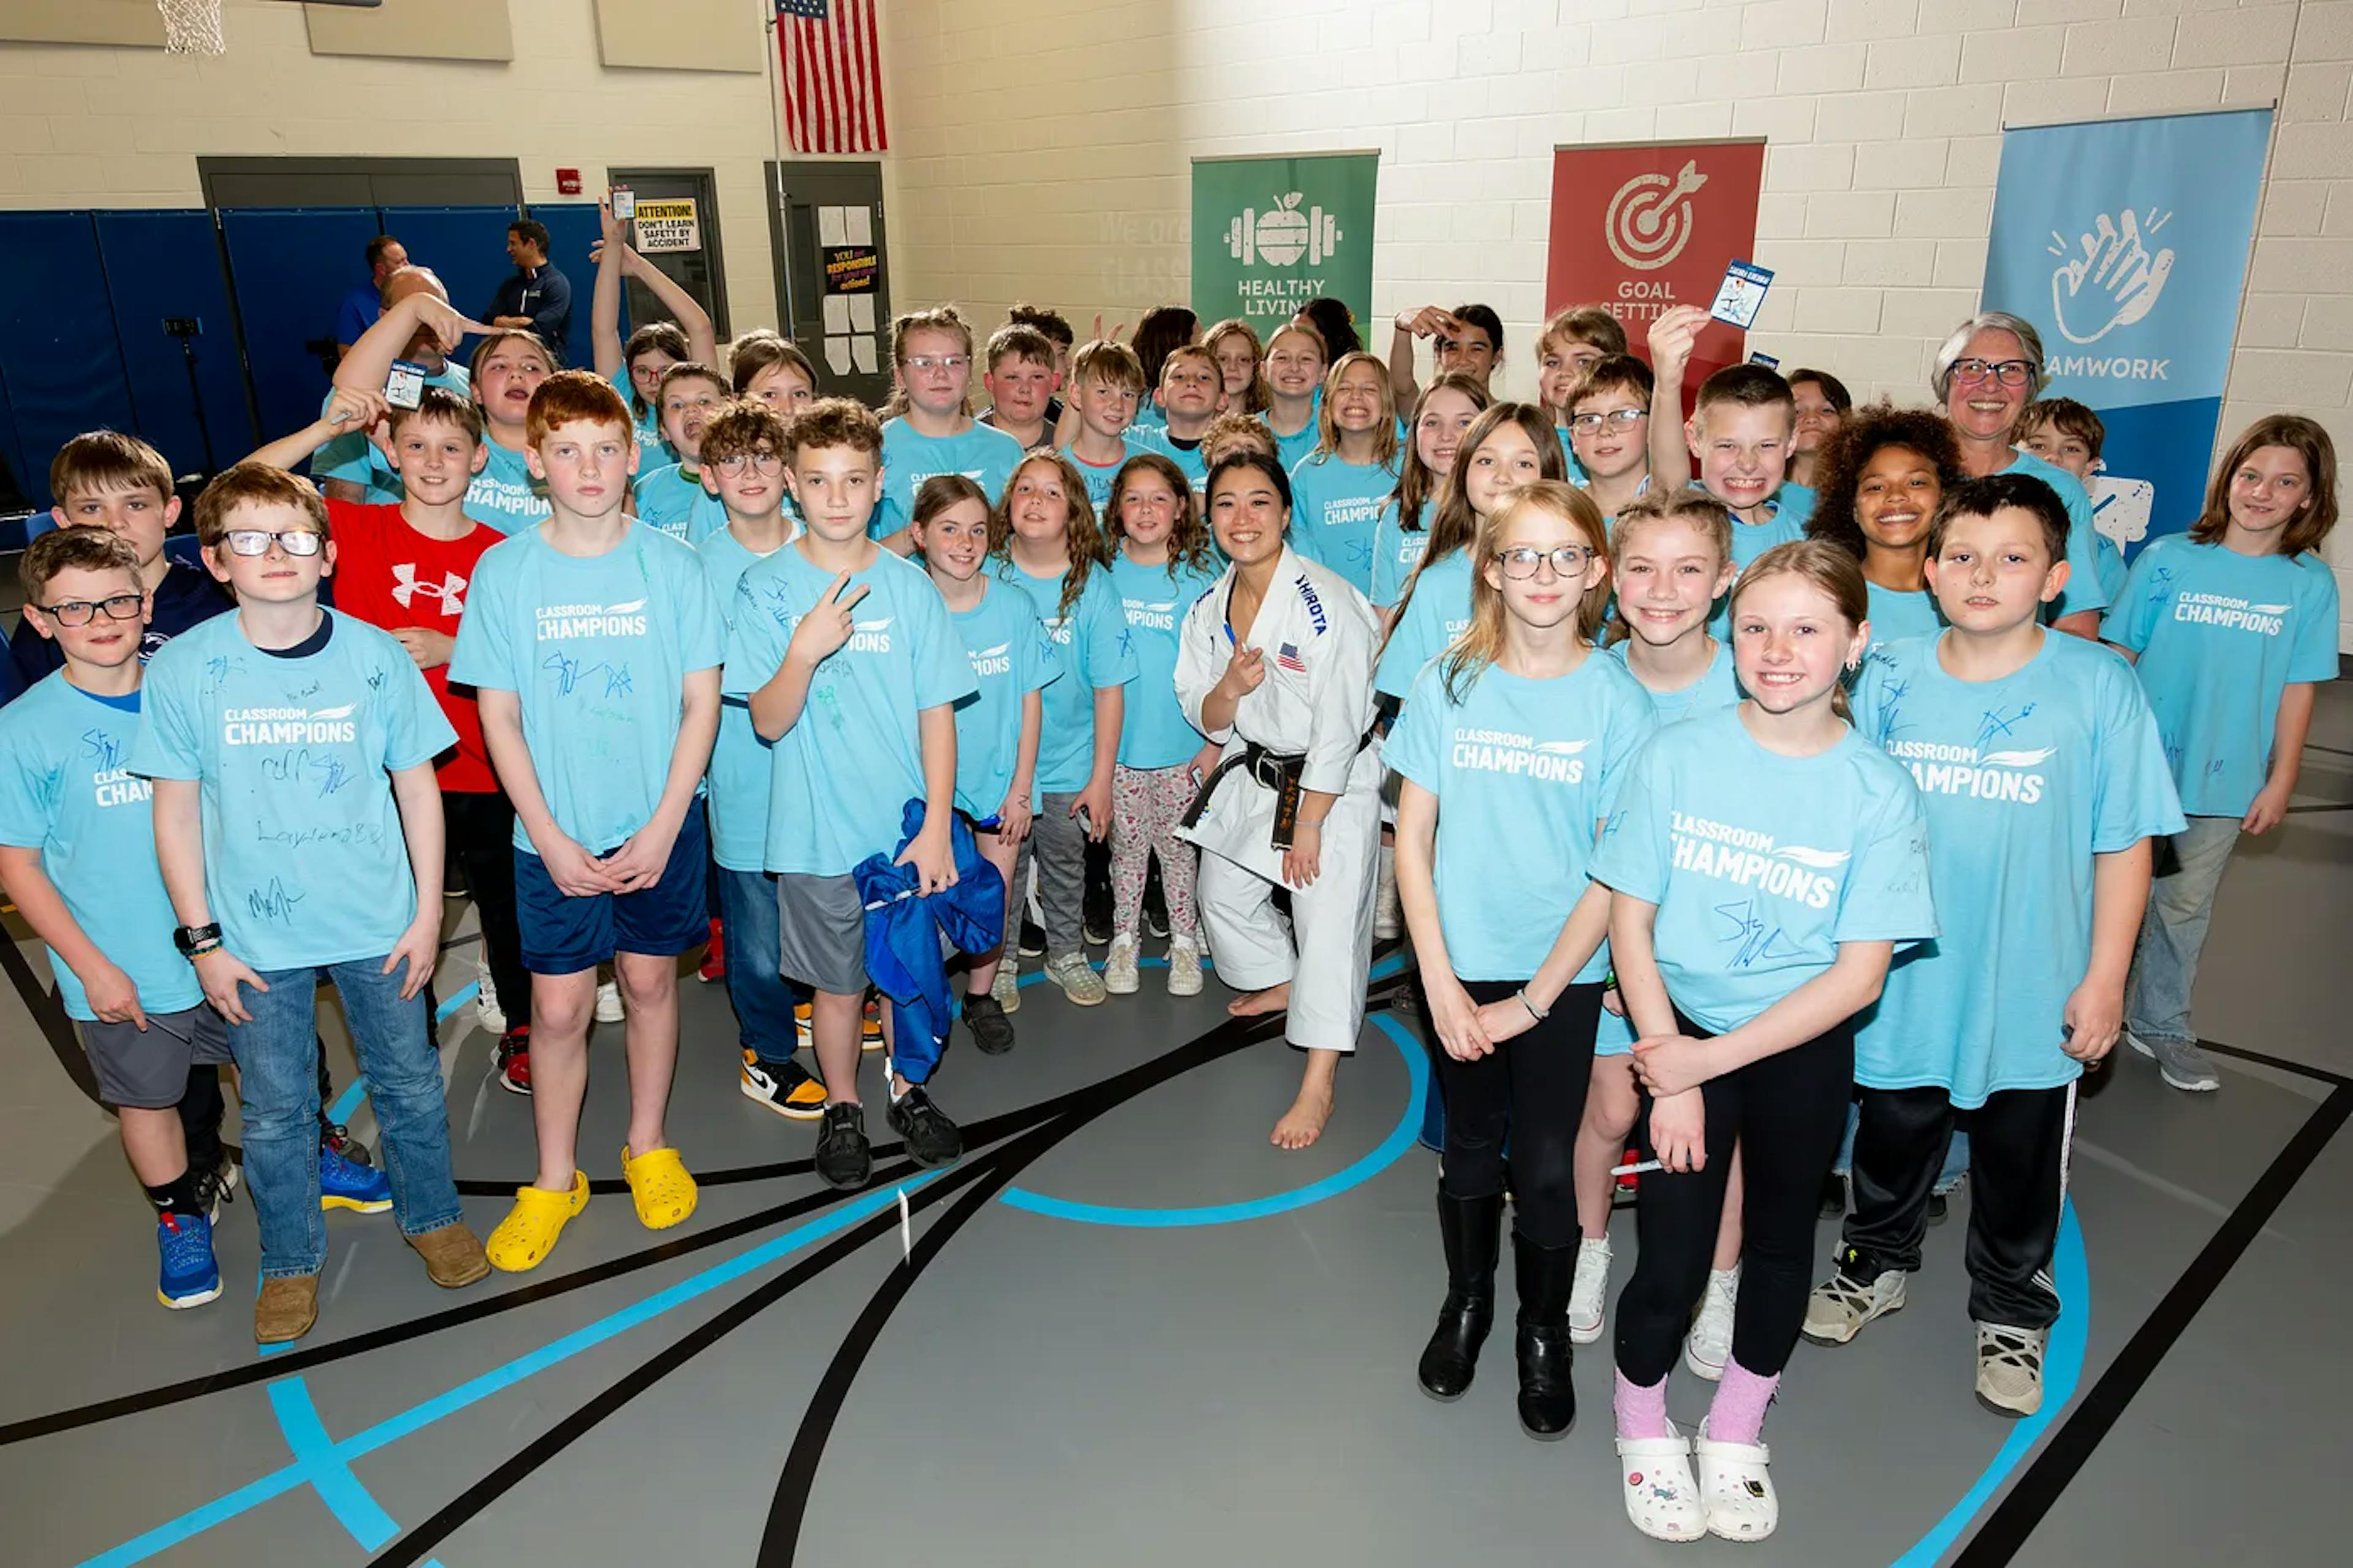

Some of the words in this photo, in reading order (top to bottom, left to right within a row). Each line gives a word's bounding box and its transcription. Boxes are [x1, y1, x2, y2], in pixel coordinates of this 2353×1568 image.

[638, 205, 692, 218] ATTENTION!
[644, 230, 675, 238] SAFETY
[648, 238, 689, 247] ACCIDENT
[1238, 279, 1325, 295] HEALTHY
[1618, 282, 1676, 299] GOAL
[1246, 300, 1302, 315] LIVIN
[1600, 302, 1676, 320] SETTIN
[2045, 356, 2170, 380] AMWORK
[464, 485, 553, 516] HAMPION
[2179, 591, 2248, 609] CLASSROOM
[537, 615, 646, 641] CHAMPIONS
[2175, 604, 2283, 637] CHAMPIONS
[225, 708, 306, 722] CLASSROOM
[225, 722, 355, 745] CHAMPIONS
[1455, 727, 1533, 749] CLASSROOM
[1453, 744, 1585, 784] CHAMPIONS
[1902, 760, 2045, 805] AMPIONS
[1672, 811, 1773, 852] LASSROOM
[1672, 832, 1836, 909] HAMPIONS
